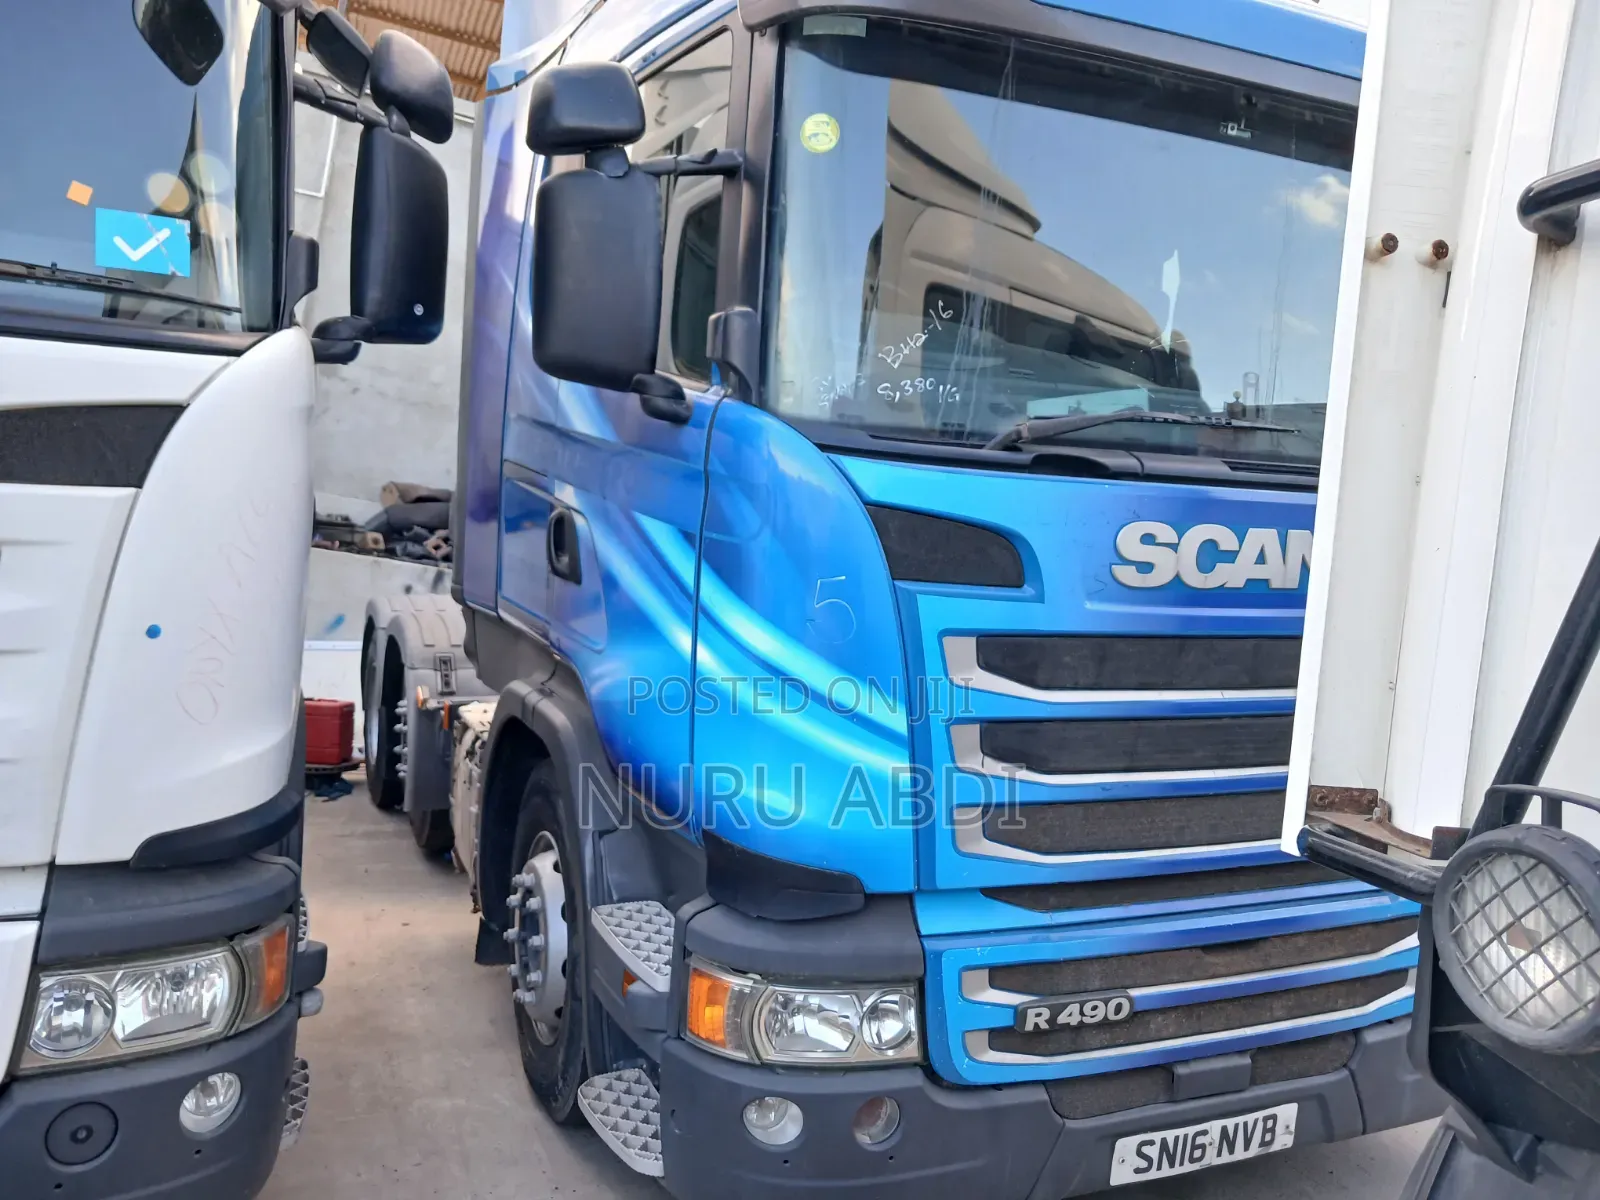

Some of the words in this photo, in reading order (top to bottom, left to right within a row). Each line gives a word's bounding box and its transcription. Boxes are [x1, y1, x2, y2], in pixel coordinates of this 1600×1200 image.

[805, 575, 857, 644] 5
[1024, 1006, 1051, 1032] R
[1056, 997, 1131, 1026] 490
[1132, 1128, 1209, 1175] SN16
[1216, 1113, 1278, 1158] NVB
